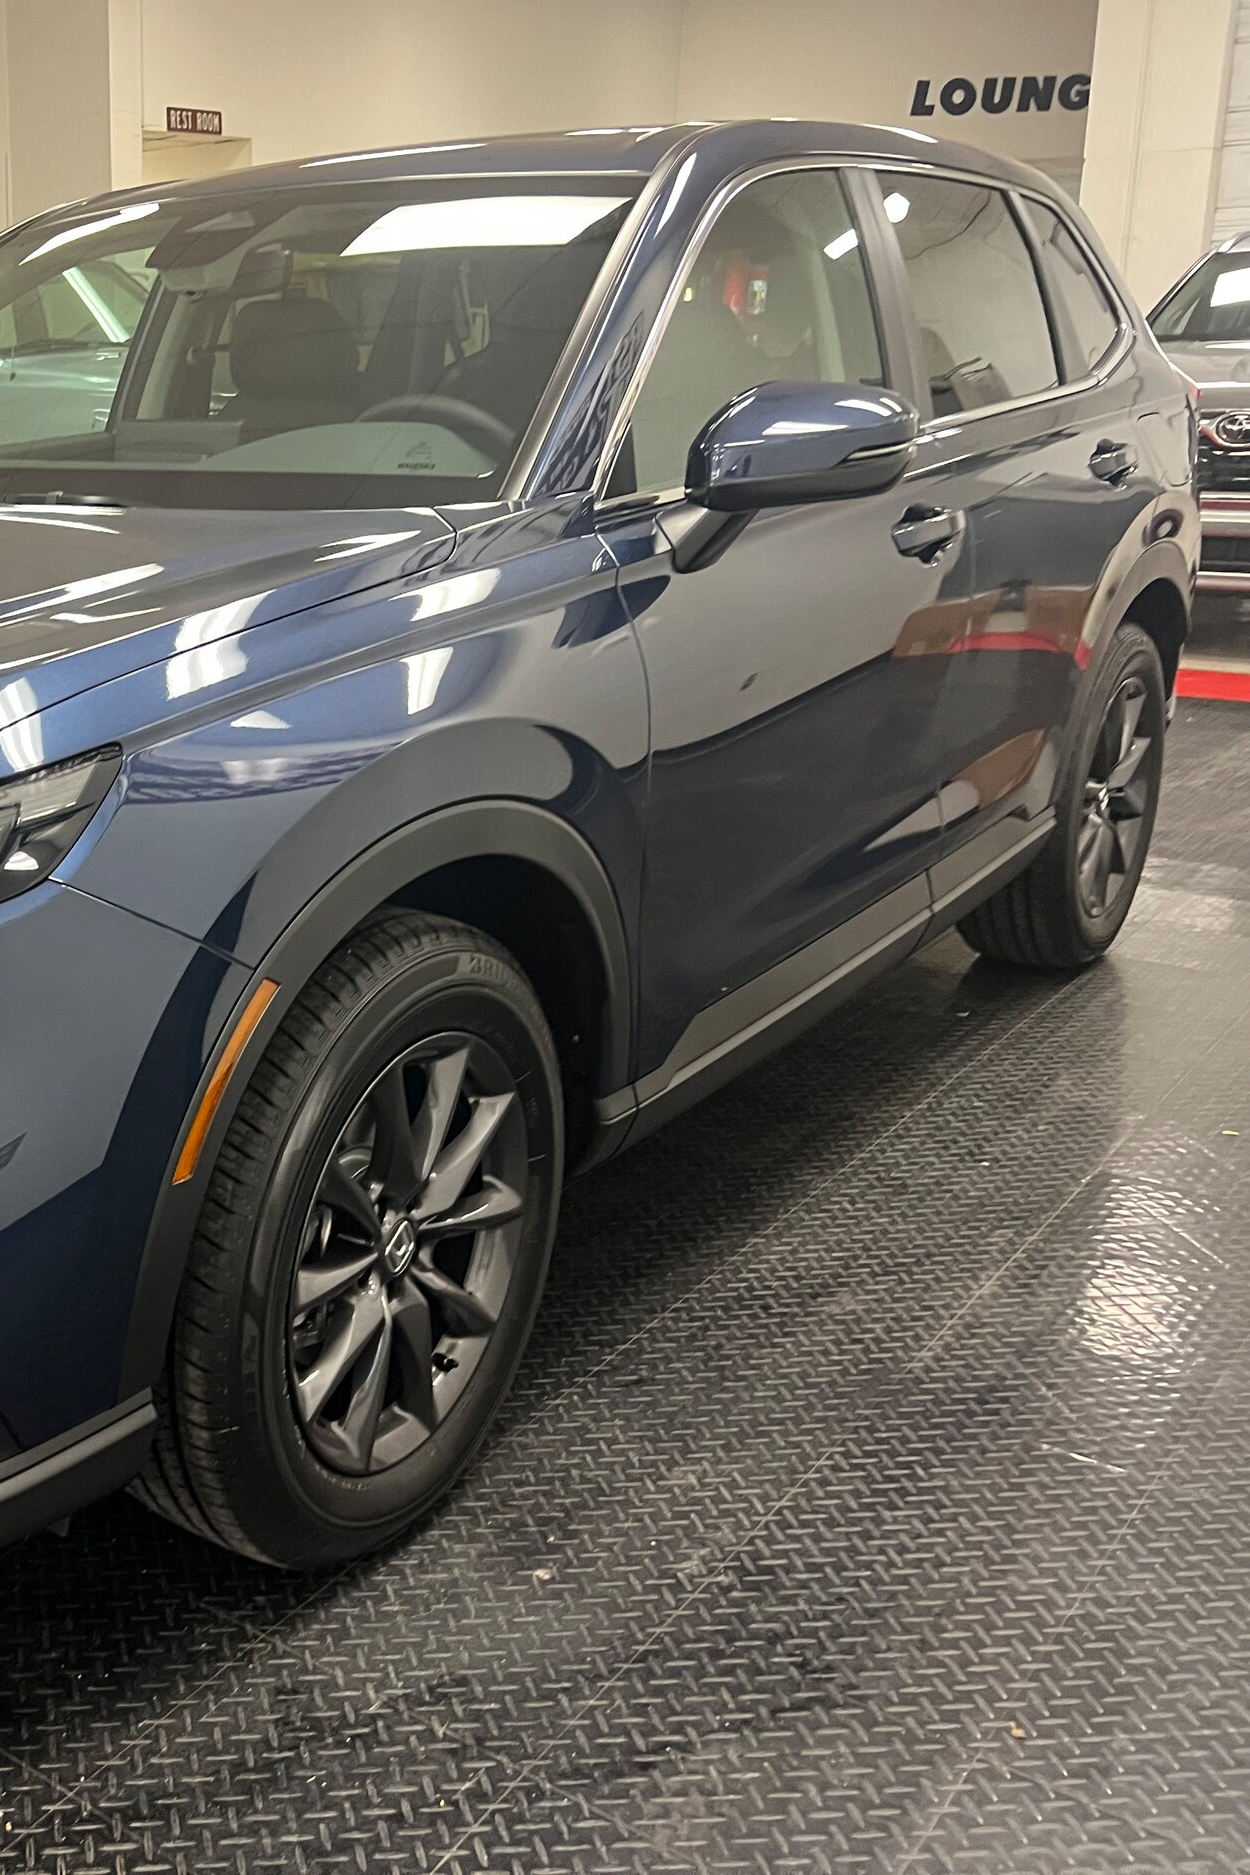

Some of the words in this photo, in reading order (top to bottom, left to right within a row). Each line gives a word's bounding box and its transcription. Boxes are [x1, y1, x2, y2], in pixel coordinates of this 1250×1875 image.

[910, 74, 1091, 116] LOUNG
[170, 110, 192, 129] REST
[196, 112, 220, 132] ROOM
